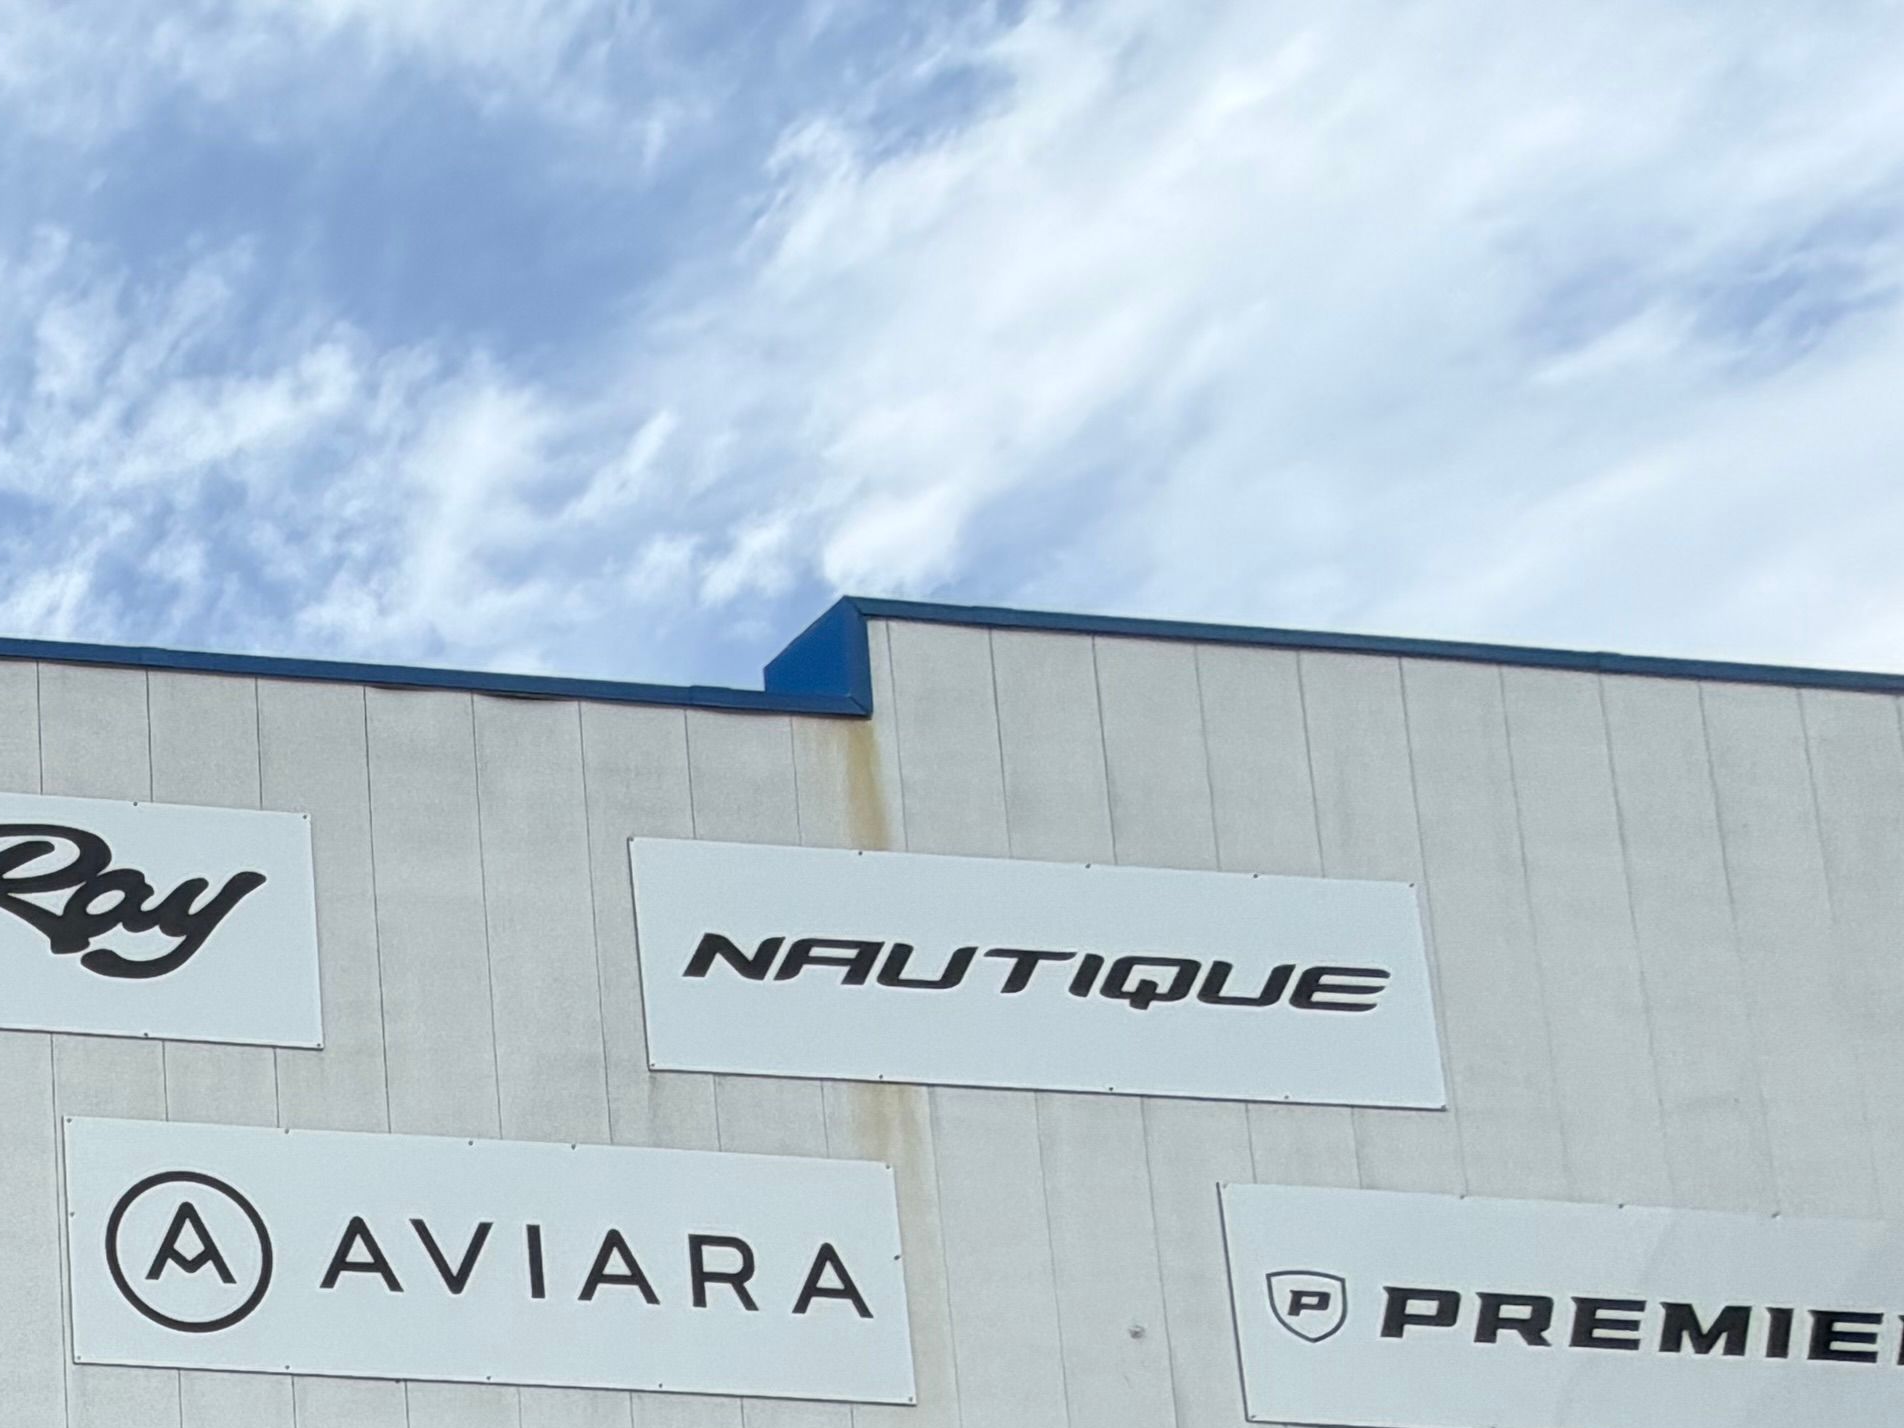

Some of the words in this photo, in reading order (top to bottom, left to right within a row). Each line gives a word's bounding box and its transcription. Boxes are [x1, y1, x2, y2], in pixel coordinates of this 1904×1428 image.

[682, 932, 1391, 1012] NAUTIQUE
[319, 1215, 874, 1319] AVIARA
[1287, 1289, 1331, 1317] P
[1380, 1286, 1904, 1366] PREMIE
